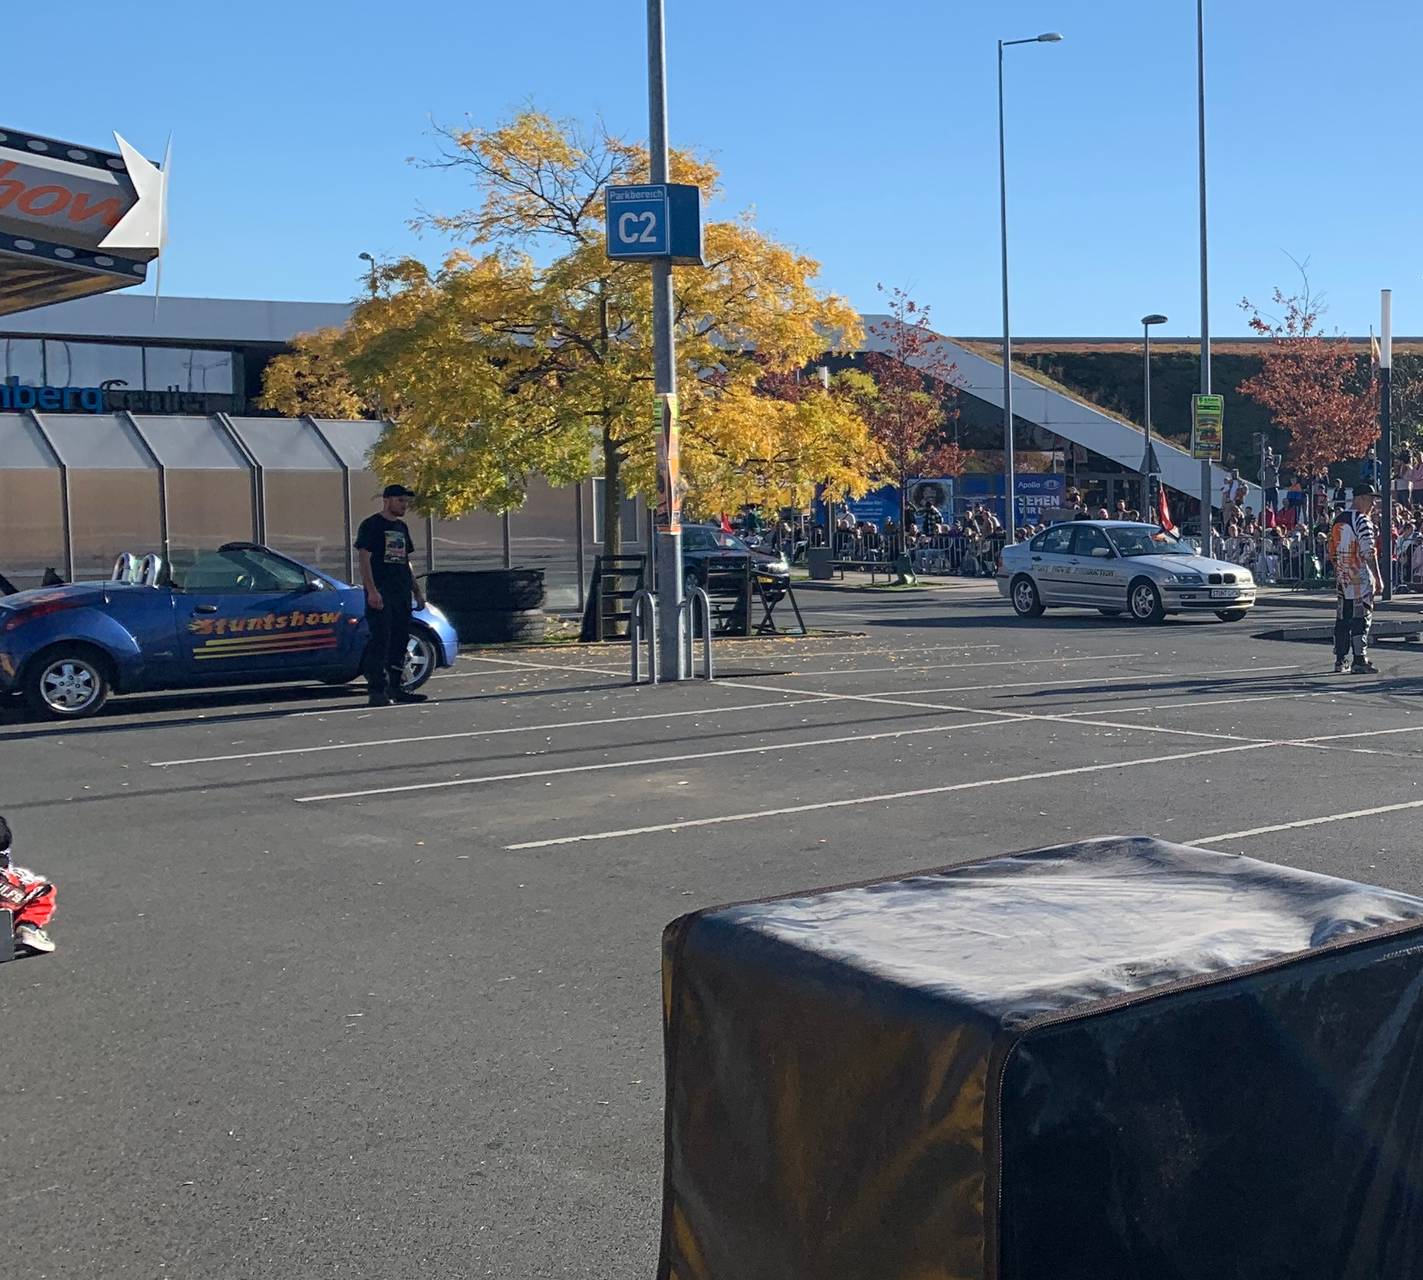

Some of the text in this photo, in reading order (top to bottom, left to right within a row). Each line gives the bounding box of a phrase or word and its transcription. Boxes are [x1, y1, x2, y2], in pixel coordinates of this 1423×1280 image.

[610, 190, 664, 200] Parkbereich
[618, 211, 657, 244] C2
[1018, 481, 1041, 489] Apollo
[1018, 495, 1060, 506] SEHEN
[188, 611, 341, 635] Stuntshow
